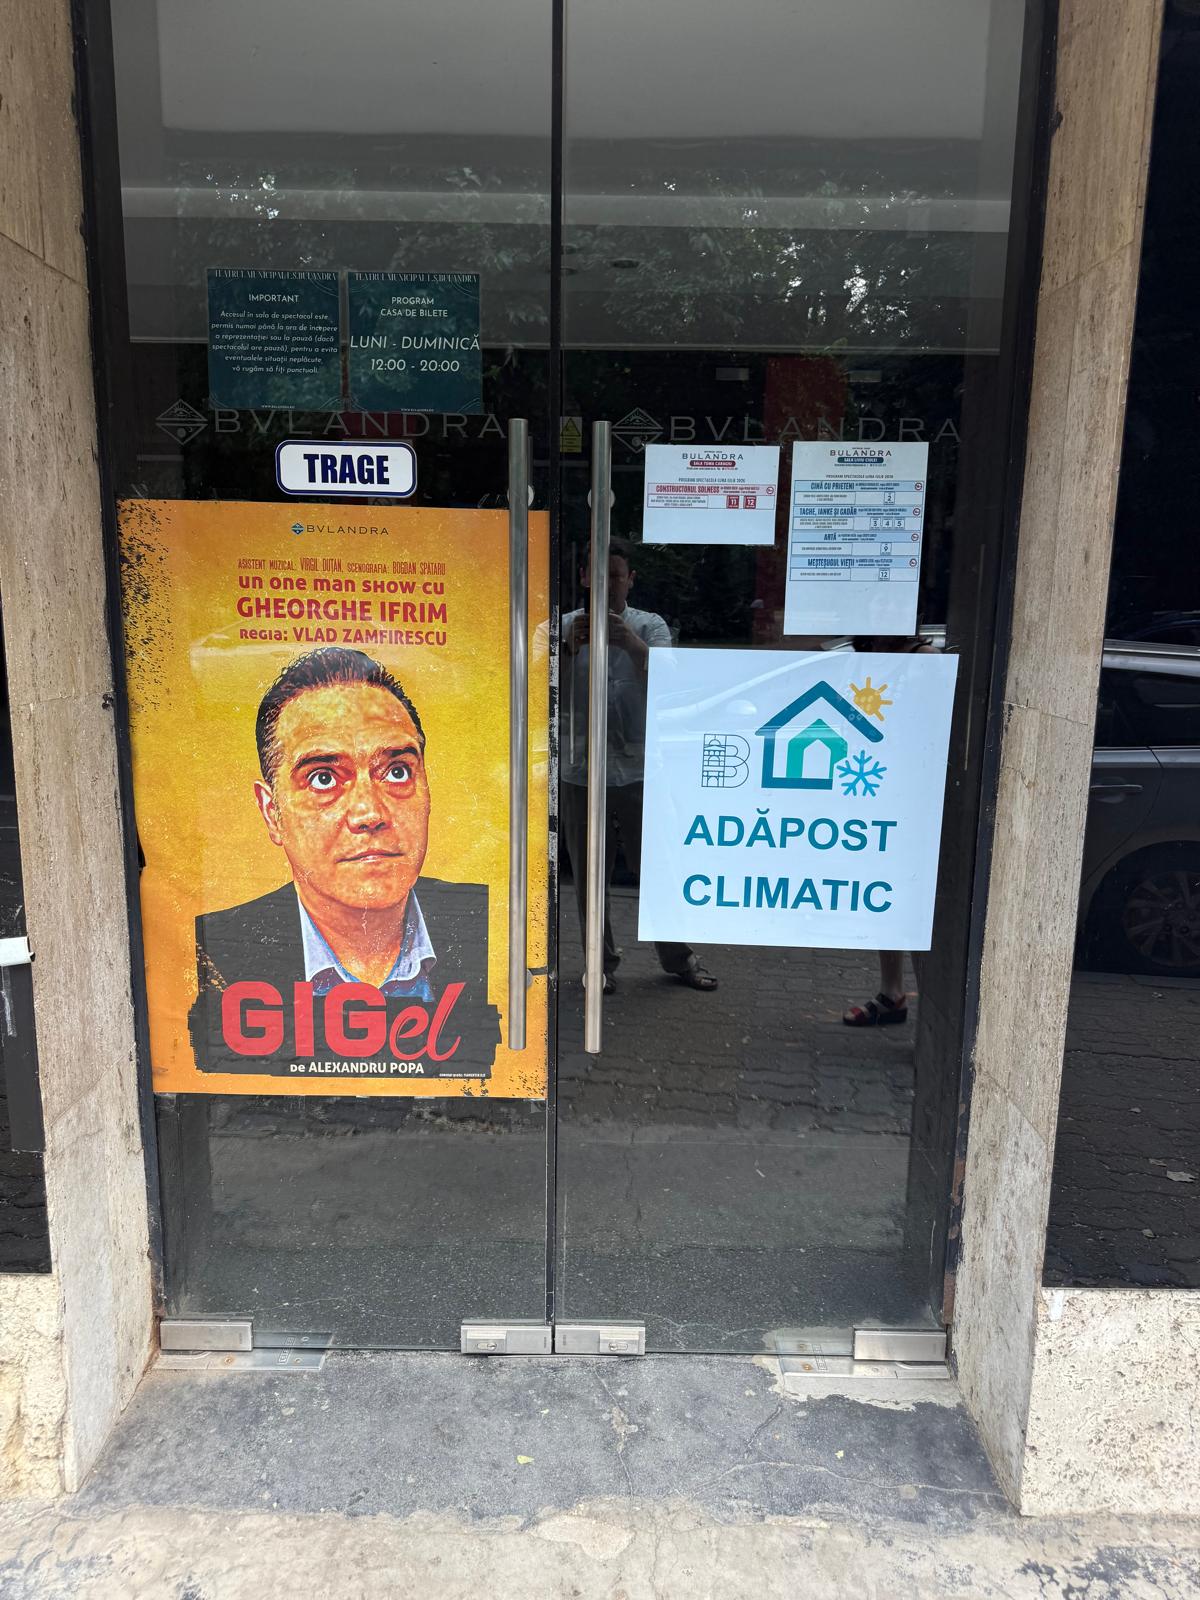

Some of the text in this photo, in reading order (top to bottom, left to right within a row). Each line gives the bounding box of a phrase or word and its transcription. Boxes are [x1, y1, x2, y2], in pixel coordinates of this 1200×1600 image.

[248, 293, 300, 303] IMPORTANT
[391, 296, 434, 305] PROGRAM
[220, 310, 246, 318] Accesul
[281, 312, 313, 322] spectacol
[380, 308, 448, 318] CASA DE BILETE
[211, 323, 234, 331] permis
[298, 323, 308, 331] de
[350, 335, 387, 349] LUNI
[401, 333, 480, 351] DUMINICĂ
[290, 346, 313, 354] pentru
[224, 353, 263, 362] eventualele
[371, 358, 406, 371] 12:00
[419, 359, 460, 372] 20:00
[681, 452, 744, 460] BULANDRA
[829, 449, 892, 457] BULANDRA
[303, 453, 390, 485] TRAGE
[655, 484, 697, 493] CONSTRUCTORUL
[697, 485, 720, 494] SOLNESS
[823, 482, 832, 490] CU
[832, 482, 855, 490] PRIETENI
[306, 524, 389, 536] BVLANDRA
[238, 558, 266, 570] ASISTENT
[300, 557, 319, 572] VIRGIL
[392, 561, 417, 575] BOGDAN
[238, 575, 264, 589] un
[269, 576, 307, 591] one
[313, 577, 356, 593] man
[421, 581, 445, 595] cu
[236, 596, 448, 624] GHEORGHE IFRIM
[292, 627, 338, 643] VLAD
[342, 628, 447, 646] ZAMFIRESCU
[683, 807, 898, 852] ADĂPOST
[682, 873, 894, 914] CLIMATIC
[221, 981, 467, 1062] GIGel
[308, 1061, 387, 1074] ALEXANDRU
[390, 1062, 425, 1074] POPA
